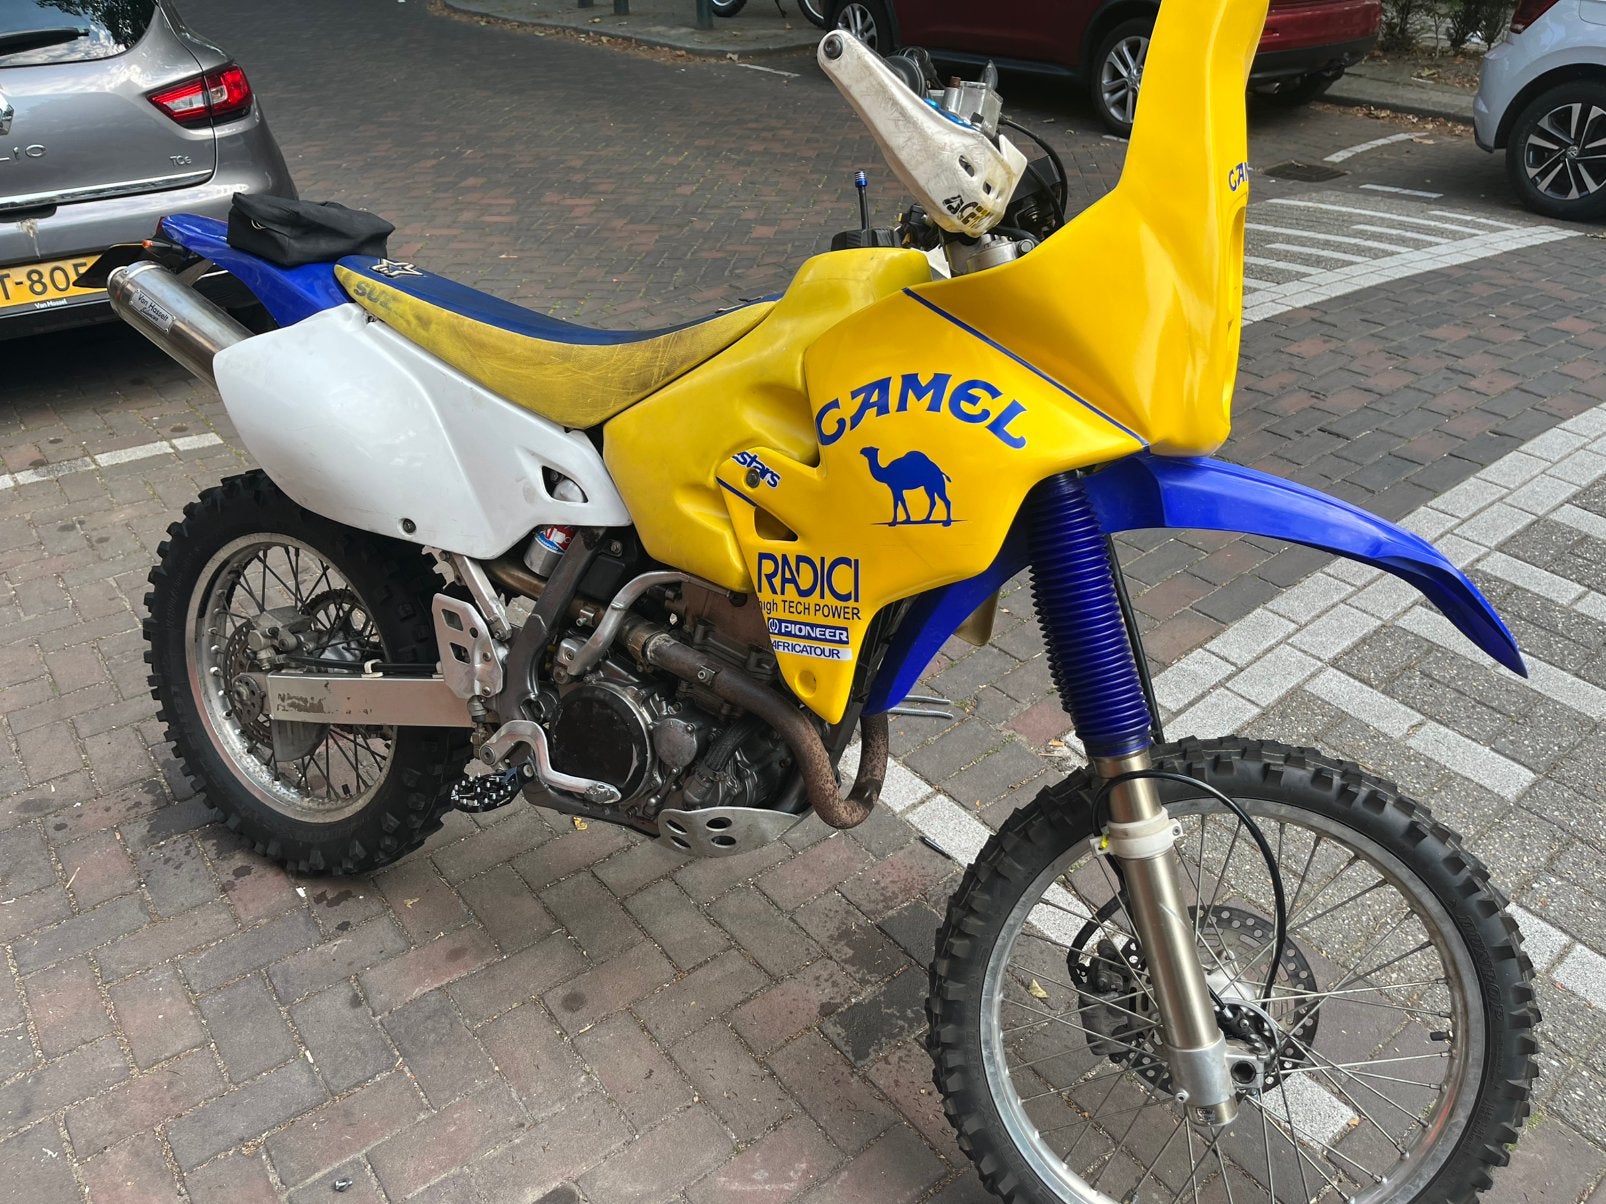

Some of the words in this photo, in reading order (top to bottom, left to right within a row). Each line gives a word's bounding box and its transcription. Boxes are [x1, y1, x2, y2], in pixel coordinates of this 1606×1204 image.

[815, 372, 1028, 449] CAMEL
[732, 451, 781, 488] stars
[757, 551, 861, 603] RADICI
[781, 599, 811, 617] TECH
[814, 603, 862, 621] POWER
[781, 622, 849, 641] PIONEER
